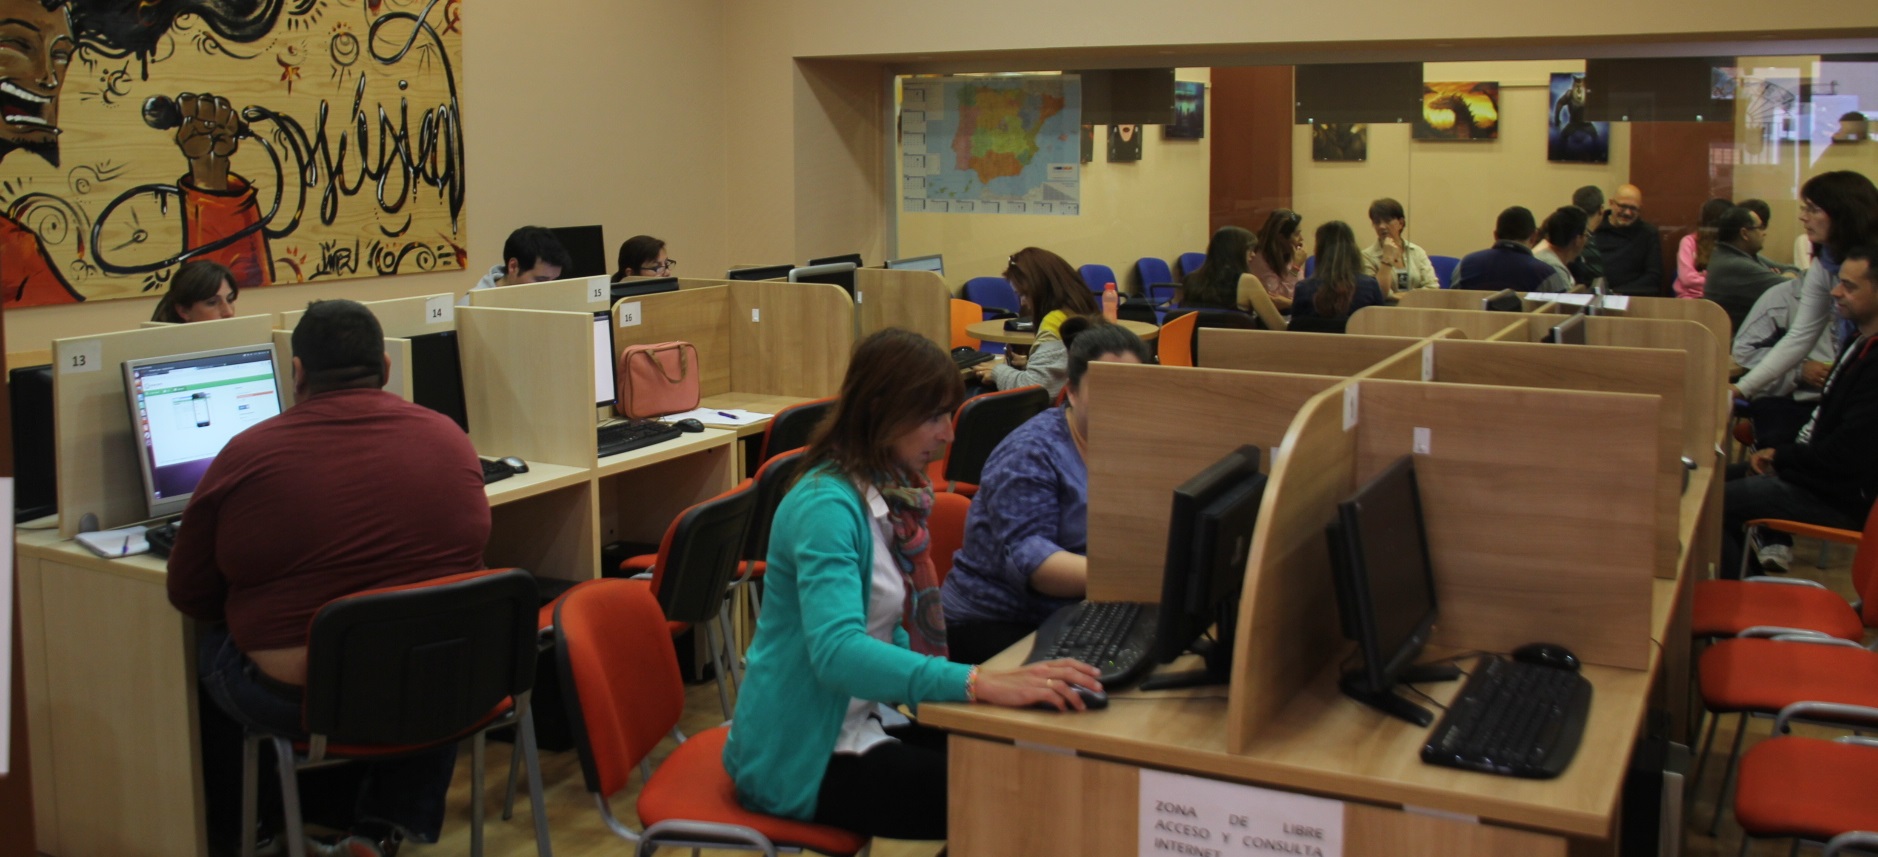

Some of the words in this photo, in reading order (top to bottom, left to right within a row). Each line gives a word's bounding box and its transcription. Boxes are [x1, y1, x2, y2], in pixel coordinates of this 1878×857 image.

[594, 289, 602, 297] 15
[432, 308, 442, 318] 14
[625, 314, 633, 322] 16
[72, 354, 86, 367] 13
[1155, 800, 1197, 818] ZONA
[1228, 814, 1249, 827] DE
[1282, 822, 1323, 839] LIBRE
[1154, 819, 1211, 840] ACCESO
[1221, 832, 1231, 844] Y
[1242, 835, 1323, 857] CONSULTA
[1154, 838, 1223, 857] INTERNET
